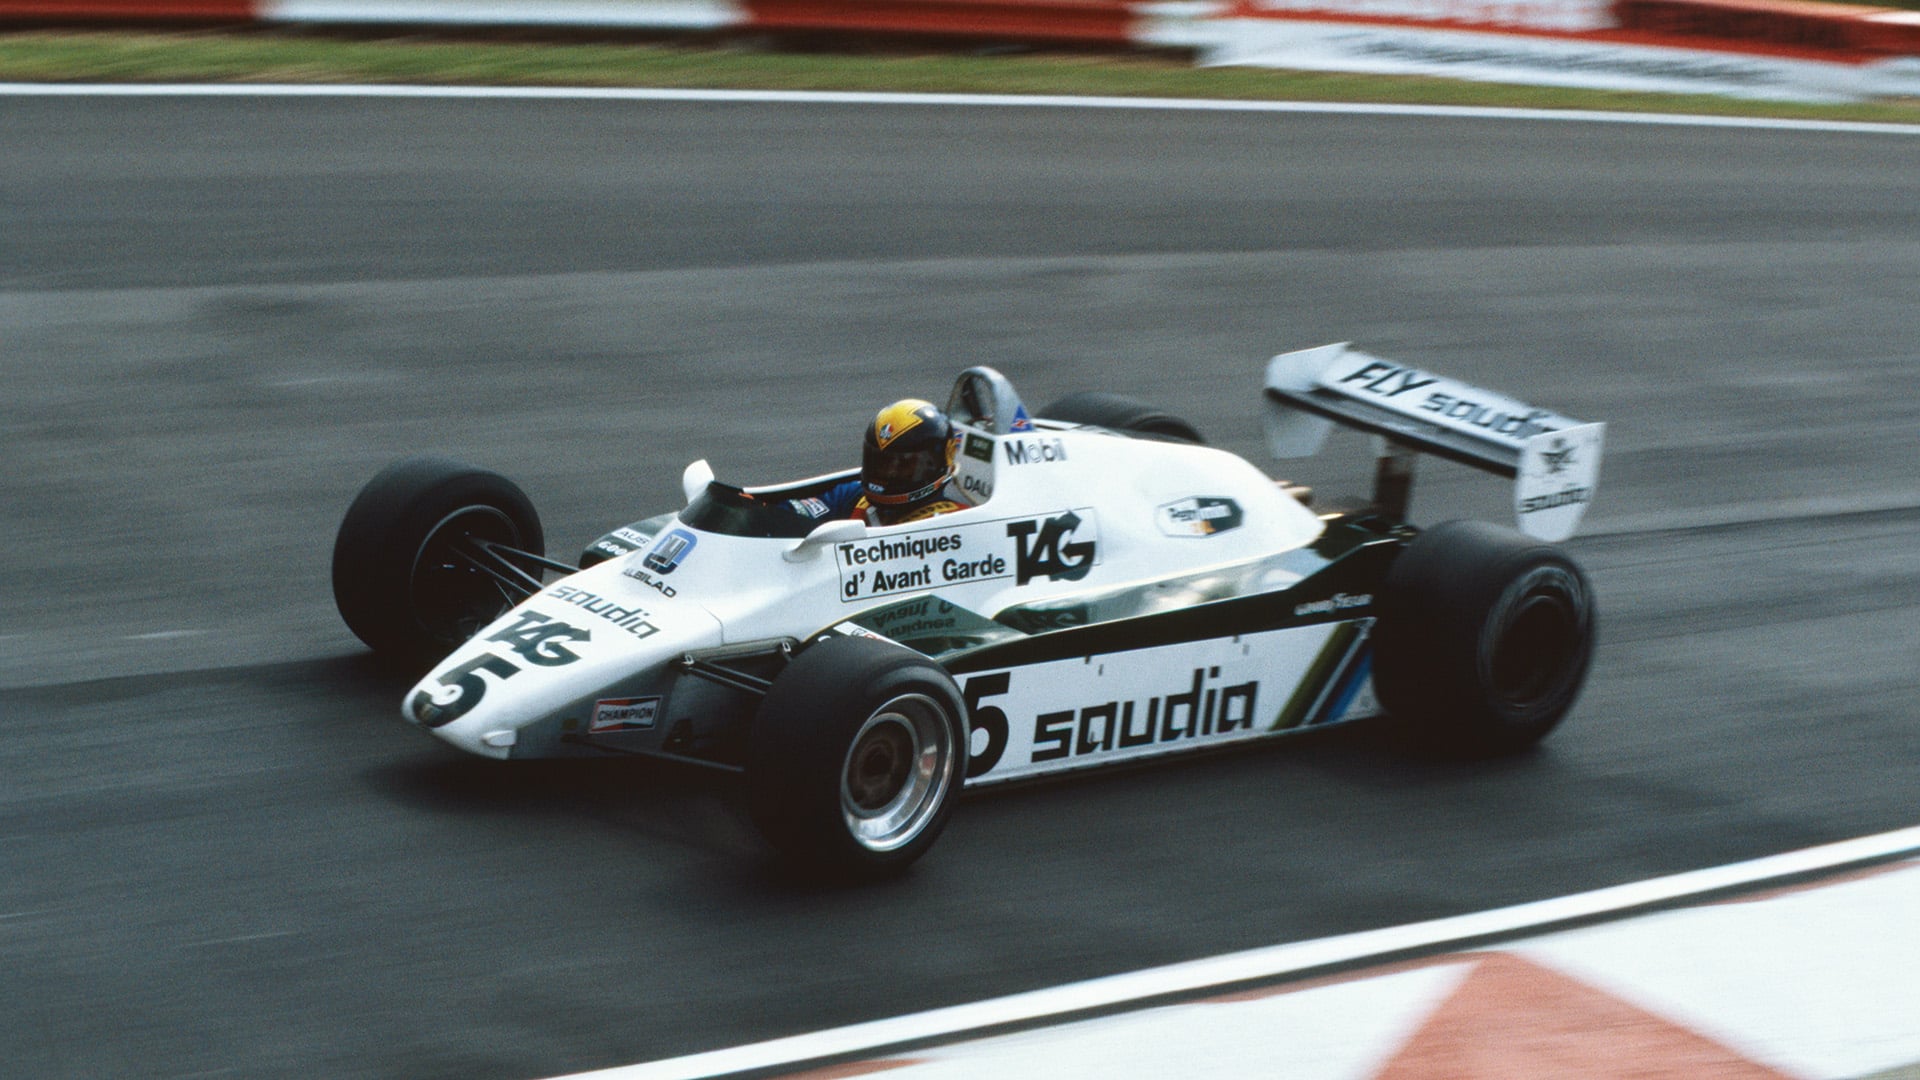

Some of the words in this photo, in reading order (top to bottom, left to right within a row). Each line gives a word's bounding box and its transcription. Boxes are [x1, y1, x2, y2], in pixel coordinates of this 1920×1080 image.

[1339, 361, 1439, 397] FLY
[1004, 438, 1067, 466] Mobil
[839, 534, 962, 566] Techniques
[872, 564, 931, 593] Avant
[942, 553, 1006, 582] Garde
[1007, 510, 1096, 586] TAG
[485, 610, 591, 667] TAG
[546, 585, 661, 639] saudia
[412, 652, 522, 728] 5
[598, 708, 656, 722] CHAMPION
[1031, 667, 1259, 763] saudia
[965, 672, 1011, 778] 5
